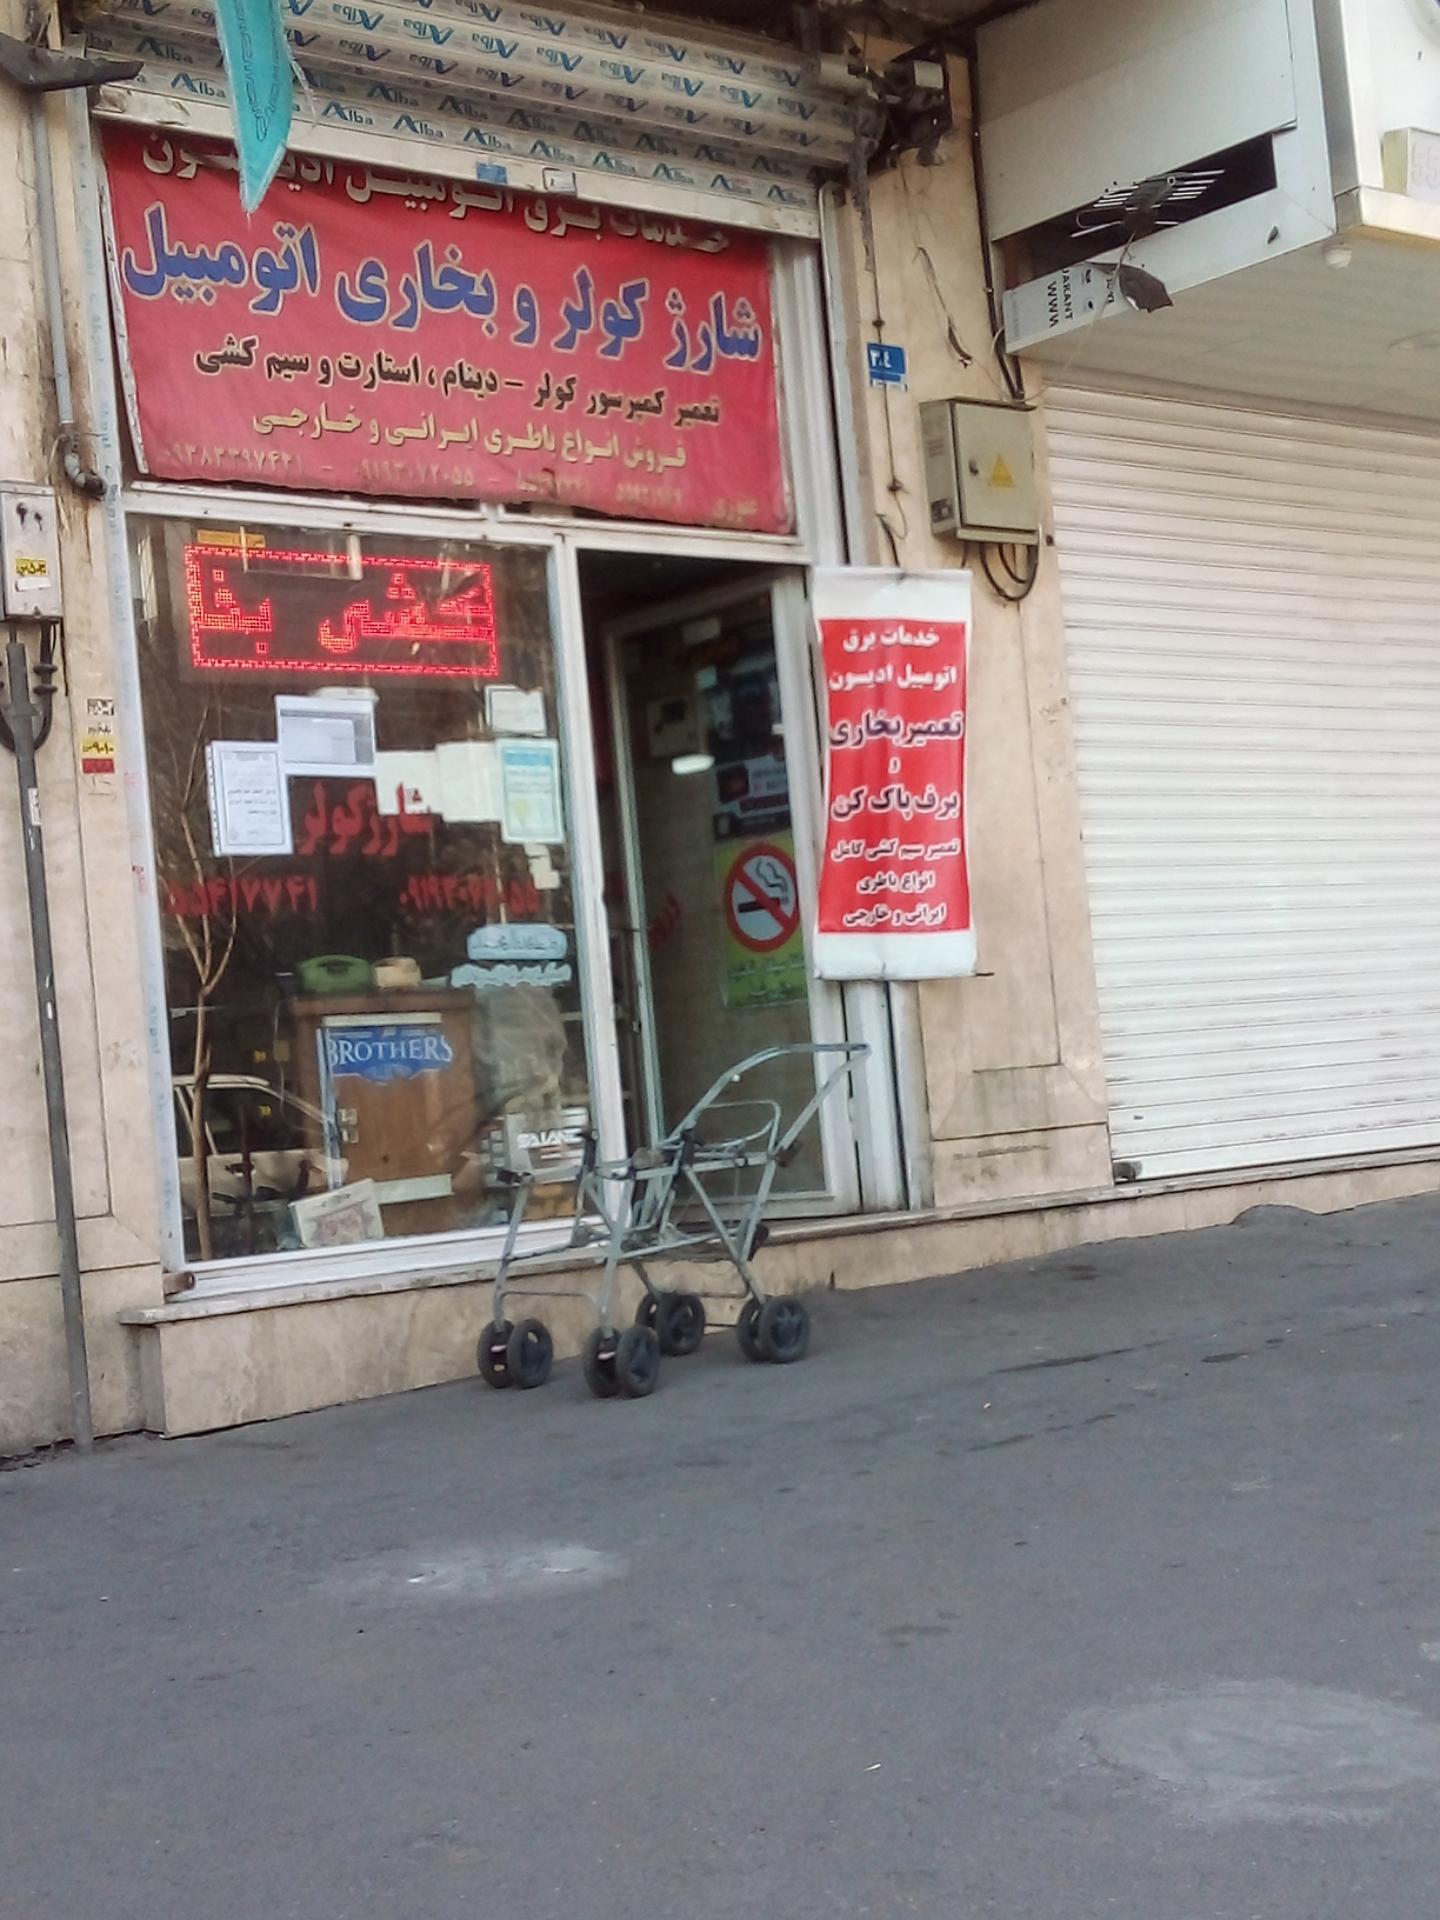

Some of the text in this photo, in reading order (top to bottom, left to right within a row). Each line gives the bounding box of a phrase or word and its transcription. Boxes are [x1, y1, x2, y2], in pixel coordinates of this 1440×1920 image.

[121, 200, 762, 375] شارژ کولر و بخاری اتومبیل
[195, 335, 259, 375] کشی
[265, 351, 311, 382] سیم
[315, 354, 333, 386] و
[338, 350, 422, 391] استارت
[532, 371, 578, 410] کولر
[673, 398, 721, 428] تعمیر
[253, 400, 688, 473] فروش انواع باطری ایرانی و خارجی
[843, 624, 940, 652] خدمات برق
[829, 708, 964, 748] تعمیر بخاری
[887, 756, 901, 773] و
[832, 783, 960, 820] برف پاک کن
[831, 837, 961, 862] تعمیر سیم کشی کامل
[857, 870, 936, 894] انواع باطری
[843, 902, 948, 927] ایرانی و خارجی
[326, 1034, 454, 1067] BROTHERS
